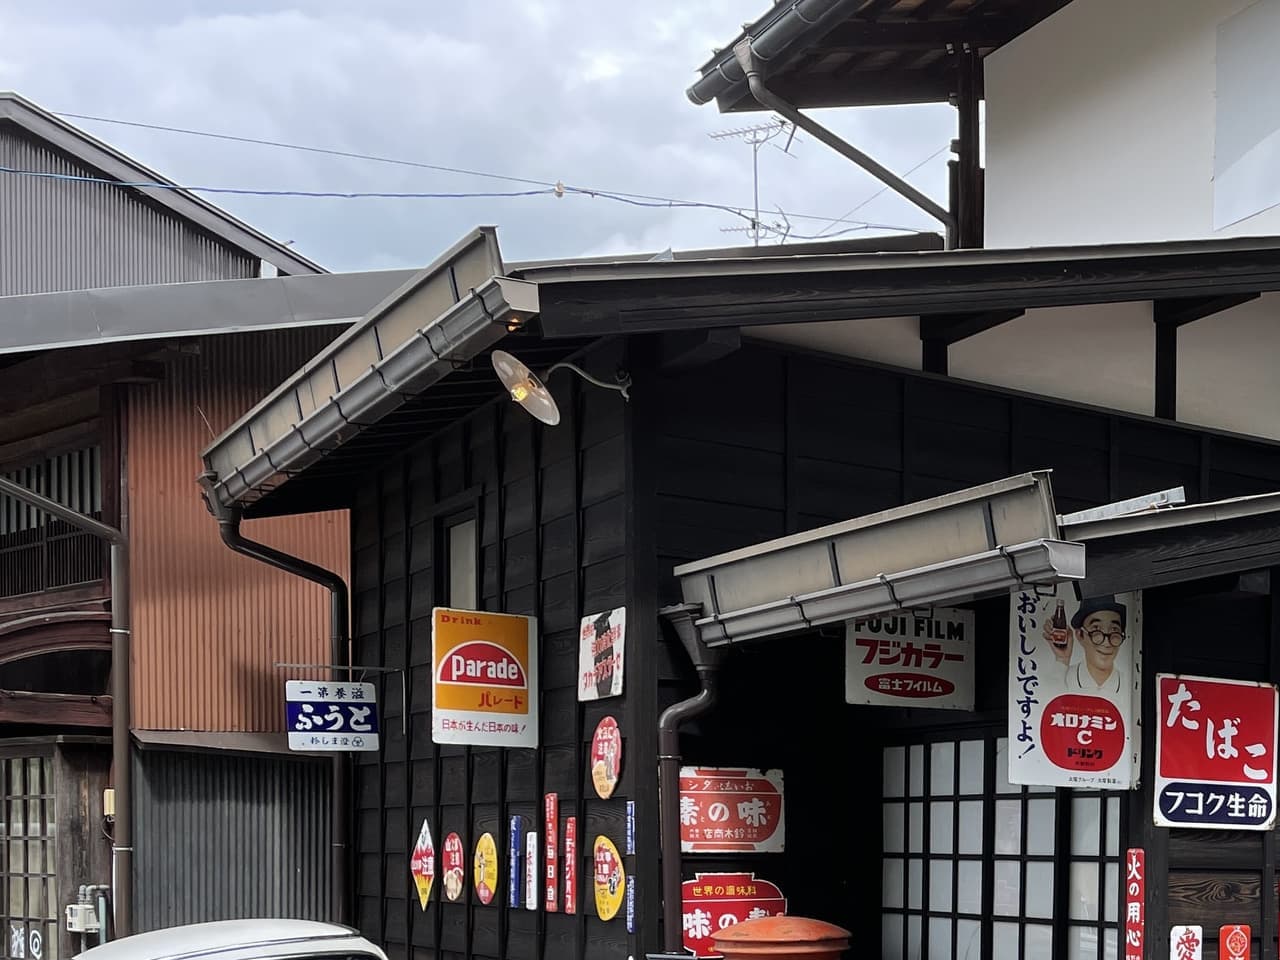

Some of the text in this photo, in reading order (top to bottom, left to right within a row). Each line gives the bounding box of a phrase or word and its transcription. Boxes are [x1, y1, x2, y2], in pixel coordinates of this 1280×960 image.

[441, 614, 481, 625] Drink
[855, 615, 964, 641] FUJI FILM
[855, 638, 965, 669] フジカラー
[878, 677, 943, 693] 富士フイルム
[479, 691, 523, 709] パレード
[1051, 713, 1117, 731] オロナミン
[1077, 730, 1093, 745] C
[1166, 682, 1269, 781] たばこ
[1067, 747, 1103, 759] ドリンク
[1165, 791, 1269, 818] フコク生命
[1127, 853, 1142, 947] 火の用心
